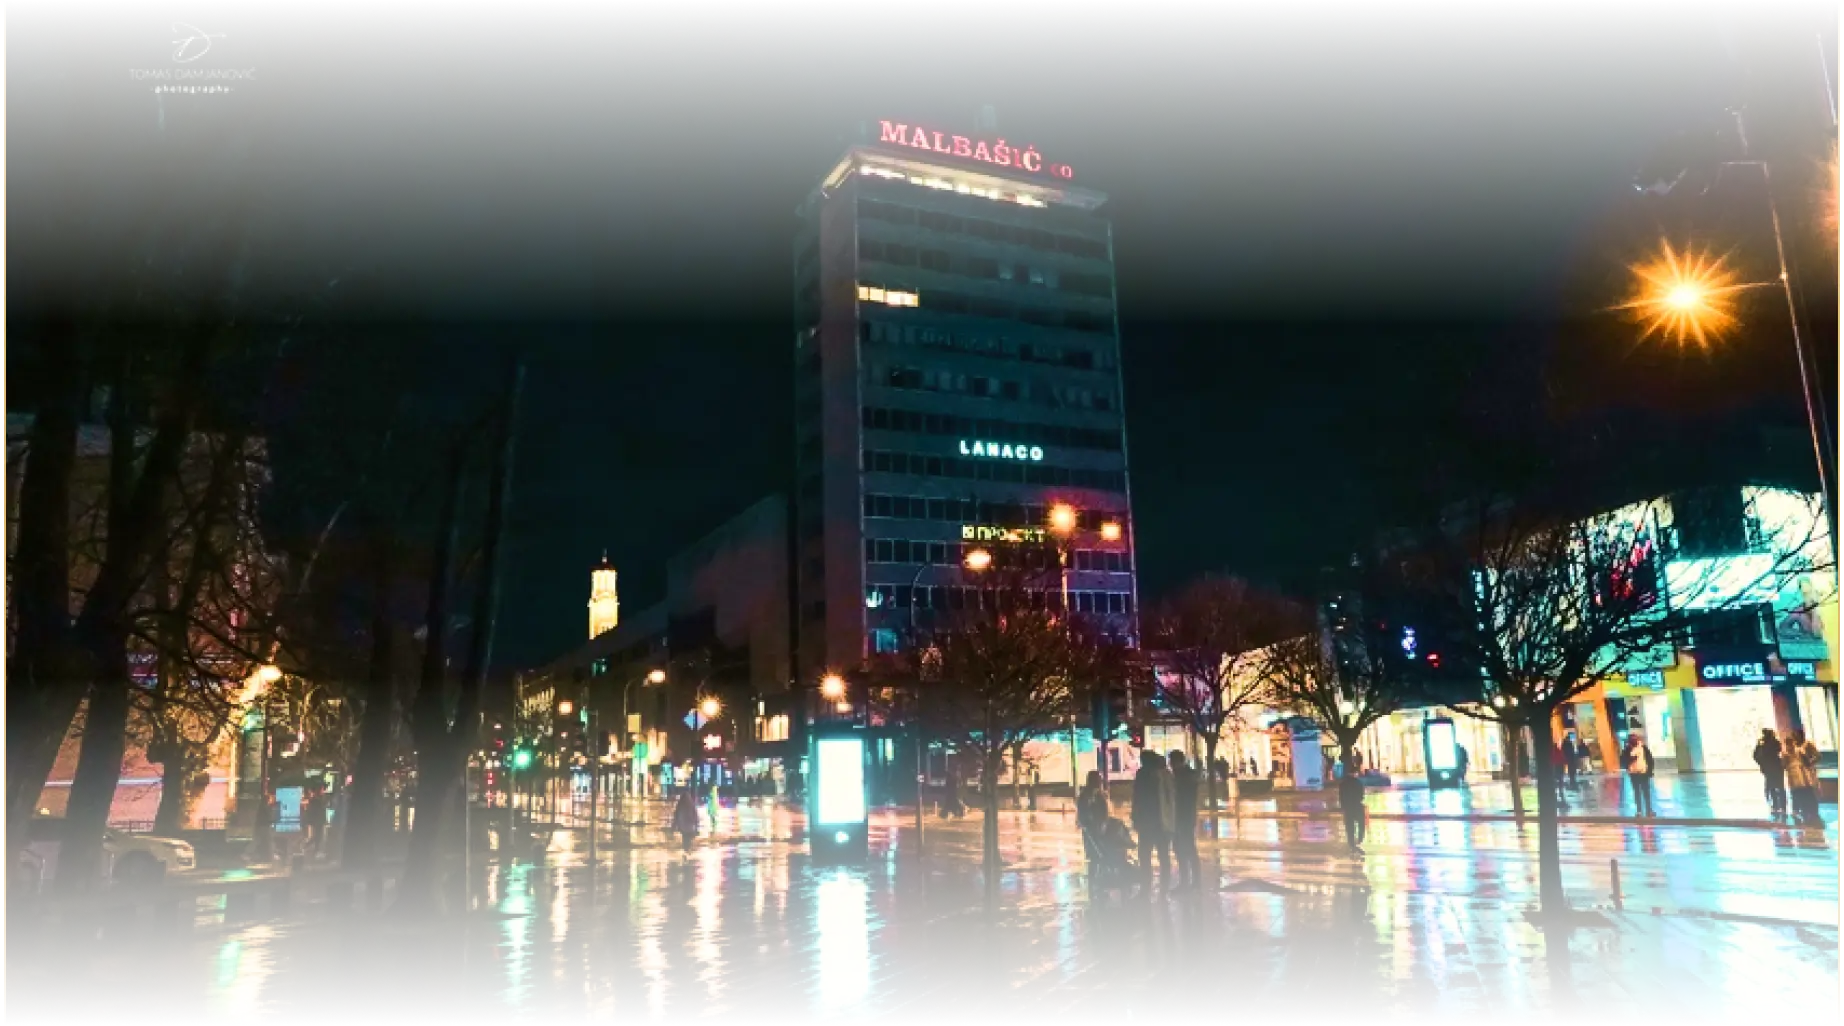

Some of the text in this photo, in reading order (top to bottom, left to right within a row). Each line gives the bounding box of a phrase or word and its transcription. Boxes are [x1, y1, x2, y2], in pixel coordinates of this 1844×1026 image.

[879, 119, 1042, 172] MALBAŠIĆ
[960, 440, 1044, 461] LANACO
[1703, 662, 1764, 679] OFFICE
